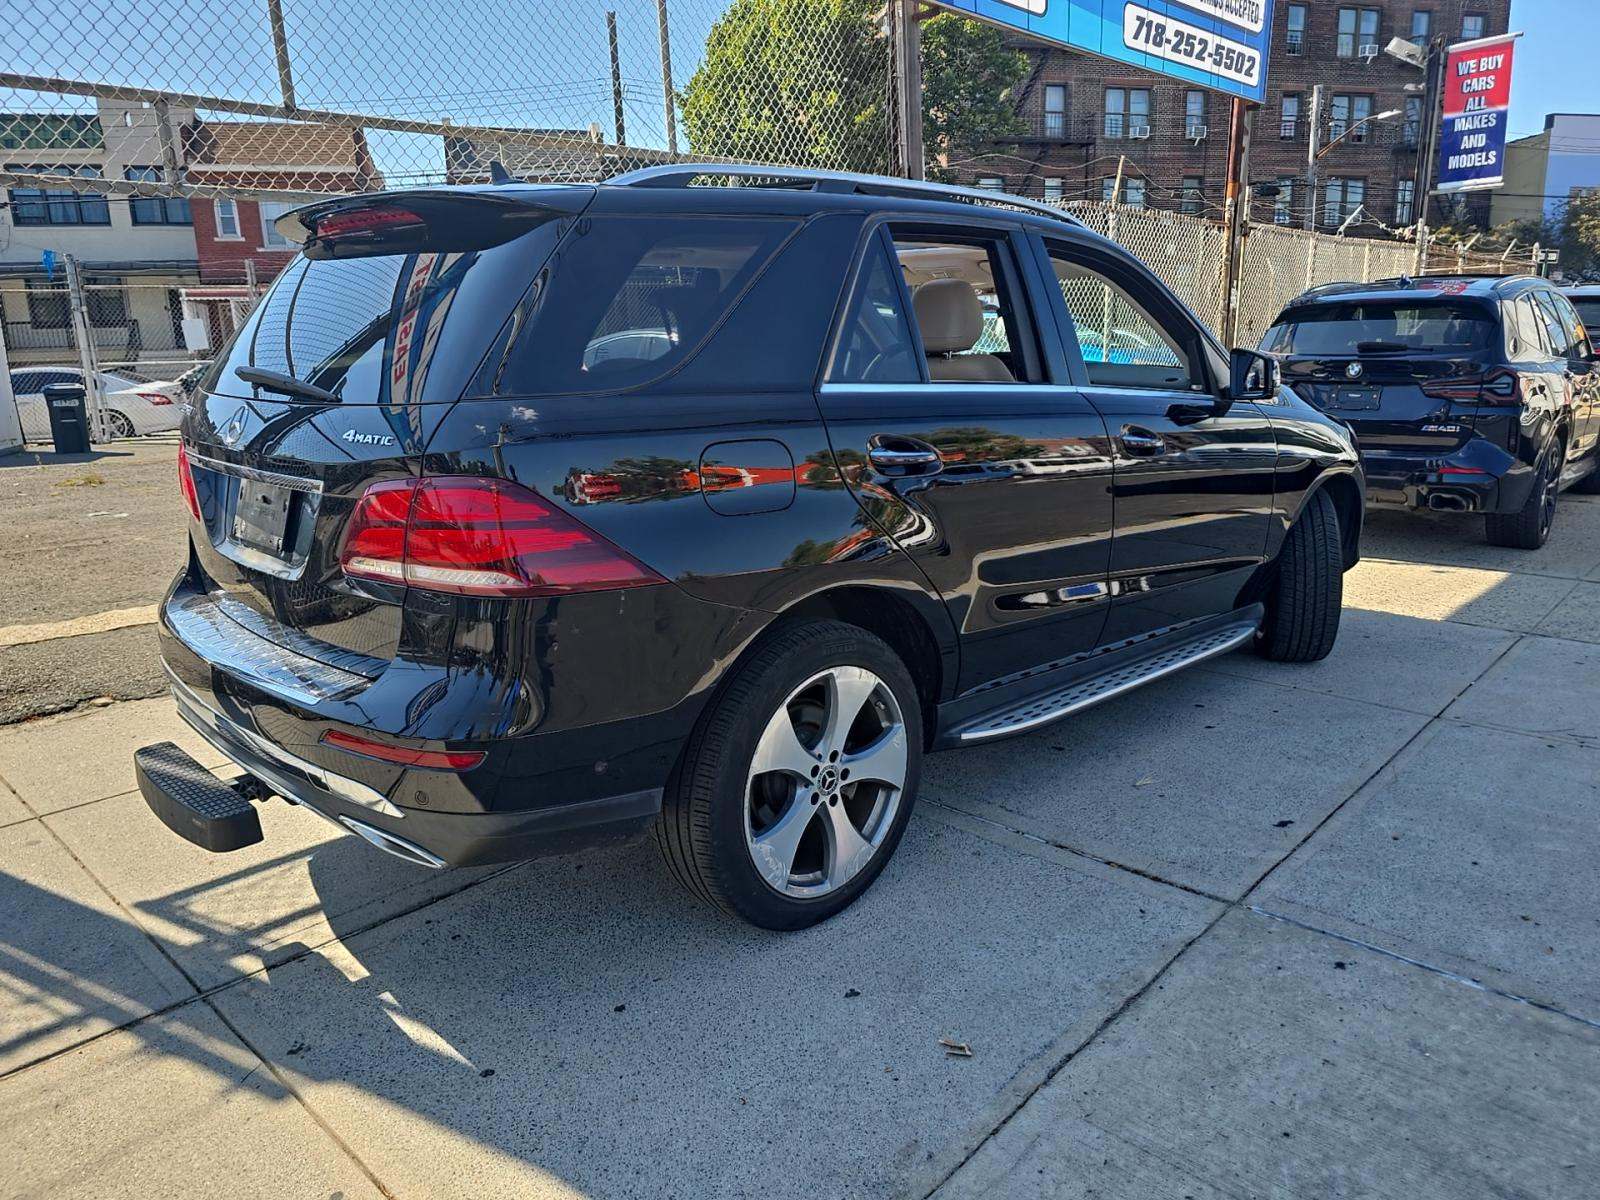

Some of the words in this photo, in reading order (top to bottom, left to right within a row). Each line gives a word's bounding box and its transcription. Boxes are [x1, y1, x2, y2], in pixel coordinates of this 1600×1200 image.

[1133, 15, 1257, 78] 718-252-5502
[1457, 59, 1478, 76] WE
[1479, 54, 1505, 72] BUY
[1461, 75, 1496, 93] CARS
[1464, 96, 1488, 112] ALL
[1454, 113, 1497, 132] MAKES
[1461, 133, 1487, 149] AND
[1448, 150, 1497, 170] MODELS
[342, 429, 394, 446] 4MATIC
